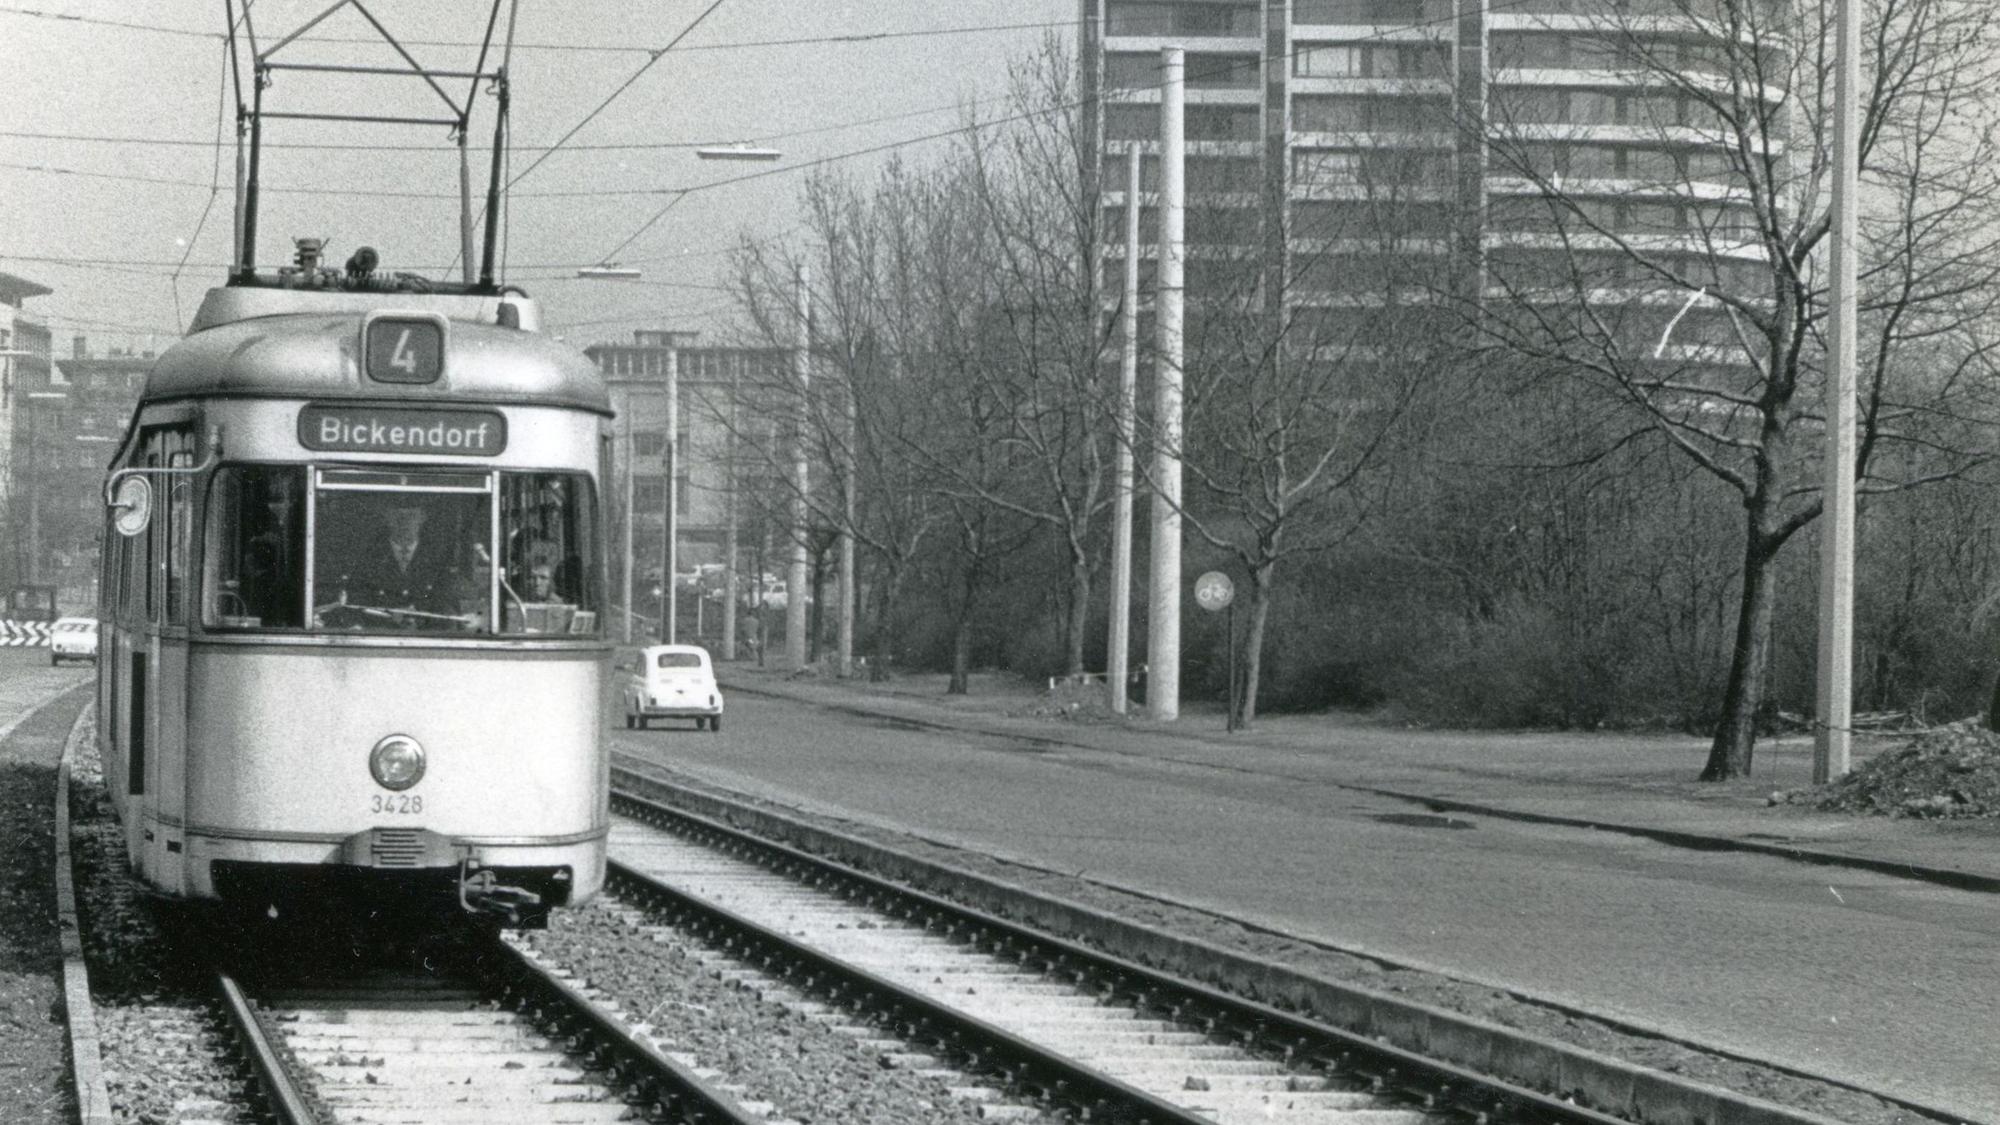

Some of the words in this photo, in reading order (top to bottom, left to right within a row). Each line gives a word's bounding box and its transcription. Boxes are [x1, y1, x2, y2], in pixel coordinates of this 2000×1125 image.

[390, 329, 417, 373] 4
[320, 416, 488, 448] Bickendorf
[371, 794, 423, 814] 3428
